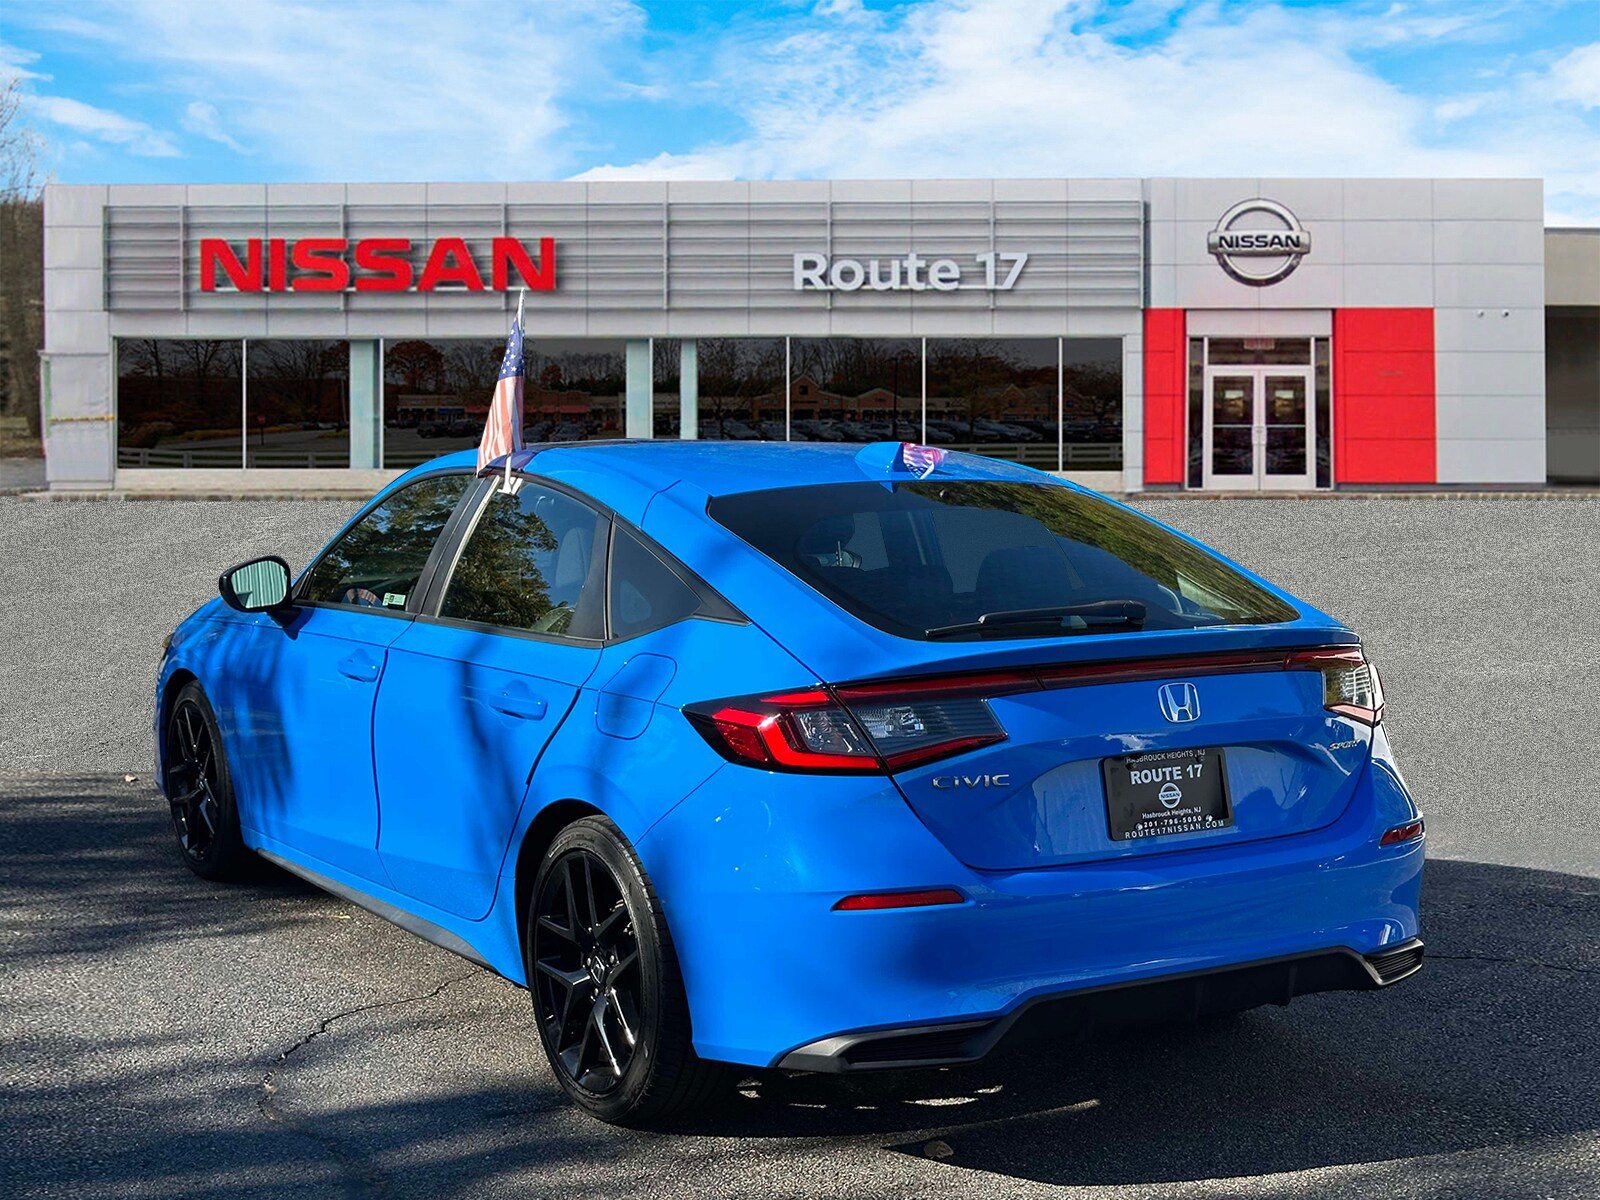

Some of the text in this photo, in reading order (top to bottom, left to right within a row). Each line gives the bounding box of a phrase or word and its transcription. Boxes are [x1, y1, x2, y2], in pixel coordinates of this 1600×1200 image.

[1218, 235, 1300, 249] NISSAN
[199, 237, 556, 292] NISSAN
[793, 251, 1029, 291] Route 17
[931, 774, 1010, 789] CIVIC
[1130, 763, 1203, 785] ROUTE 17
[1142, 810, 1170, 820] Hasbrouck
[1124, 820, 1225, 839] ROUTE17NISSAN.COM
